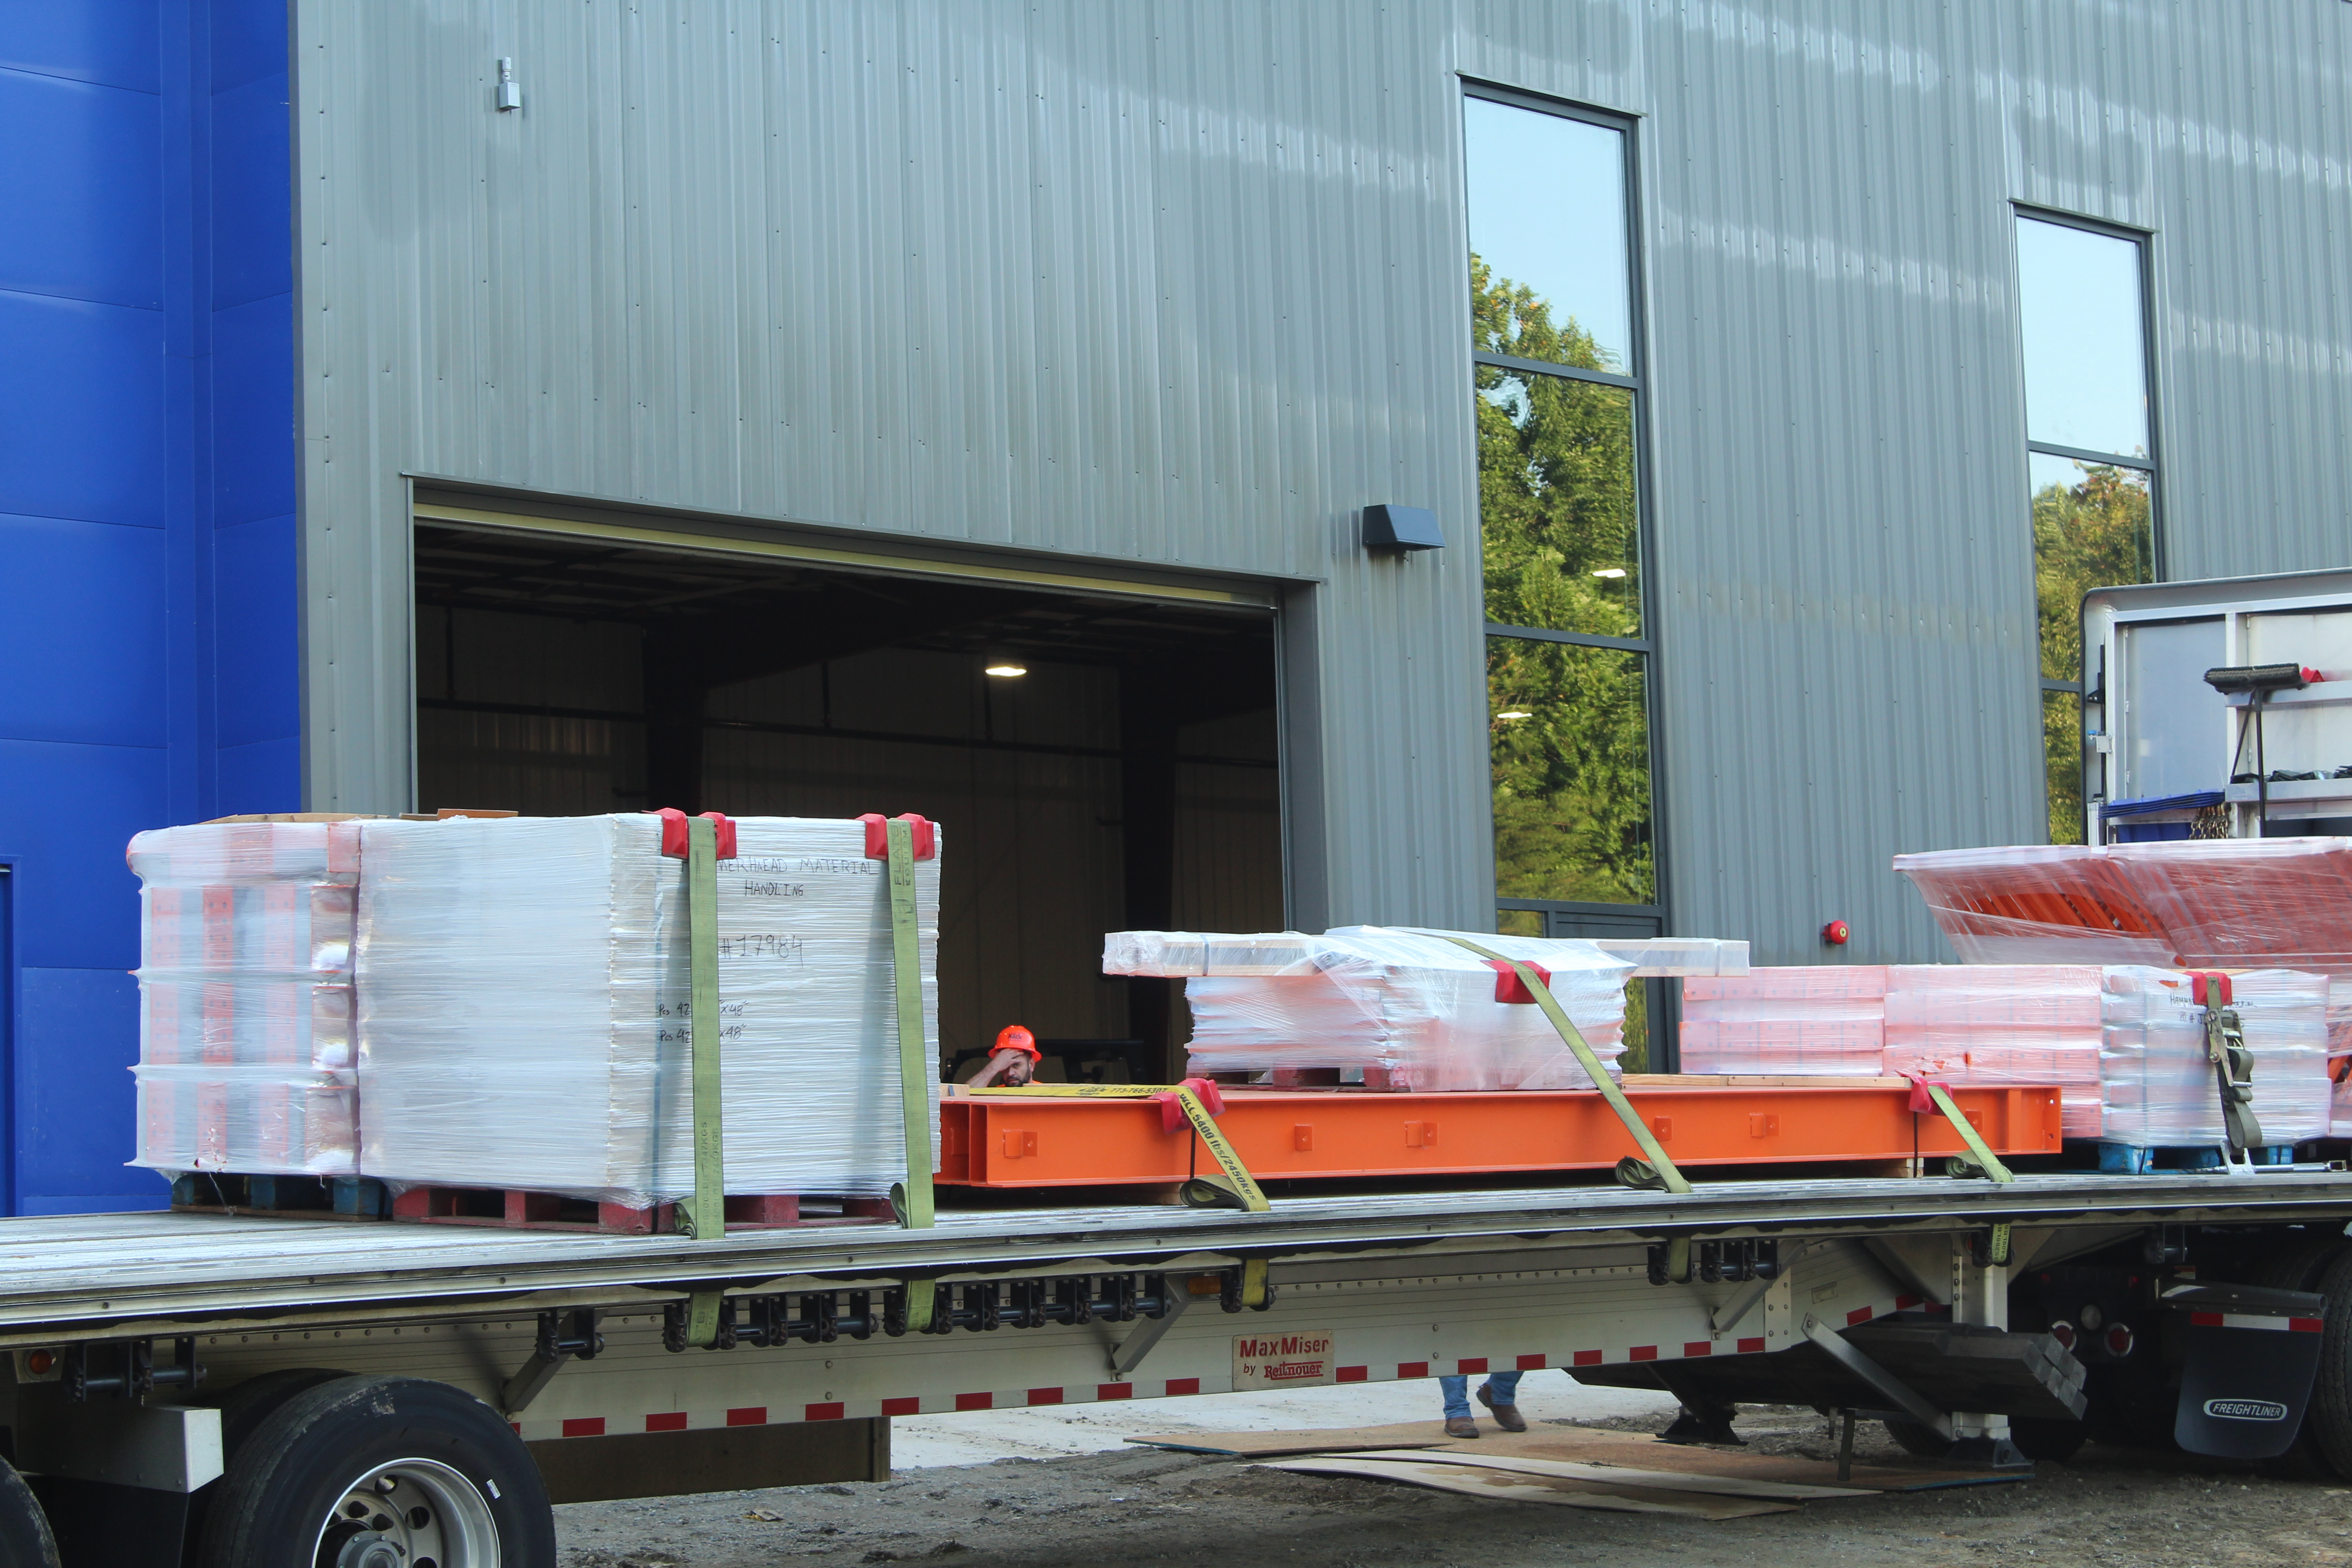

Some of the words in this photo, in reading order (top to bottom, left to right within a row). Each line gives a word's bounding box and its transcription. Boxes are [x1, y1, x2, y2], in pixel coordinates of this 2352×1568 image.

[800, 858, 879, 875] MATERIAL
[745, 879, 804, 897] HANDLING
[719, 934, 804, 968] #17984
[1192, 1114, 1215, 1139] 5400
[1243, 1362, 1256, 1376] by
[1264, 1361, 1324, 1381] Reitnouer
[2212, 1403, 2281, 1416] FREIGHTLINER
